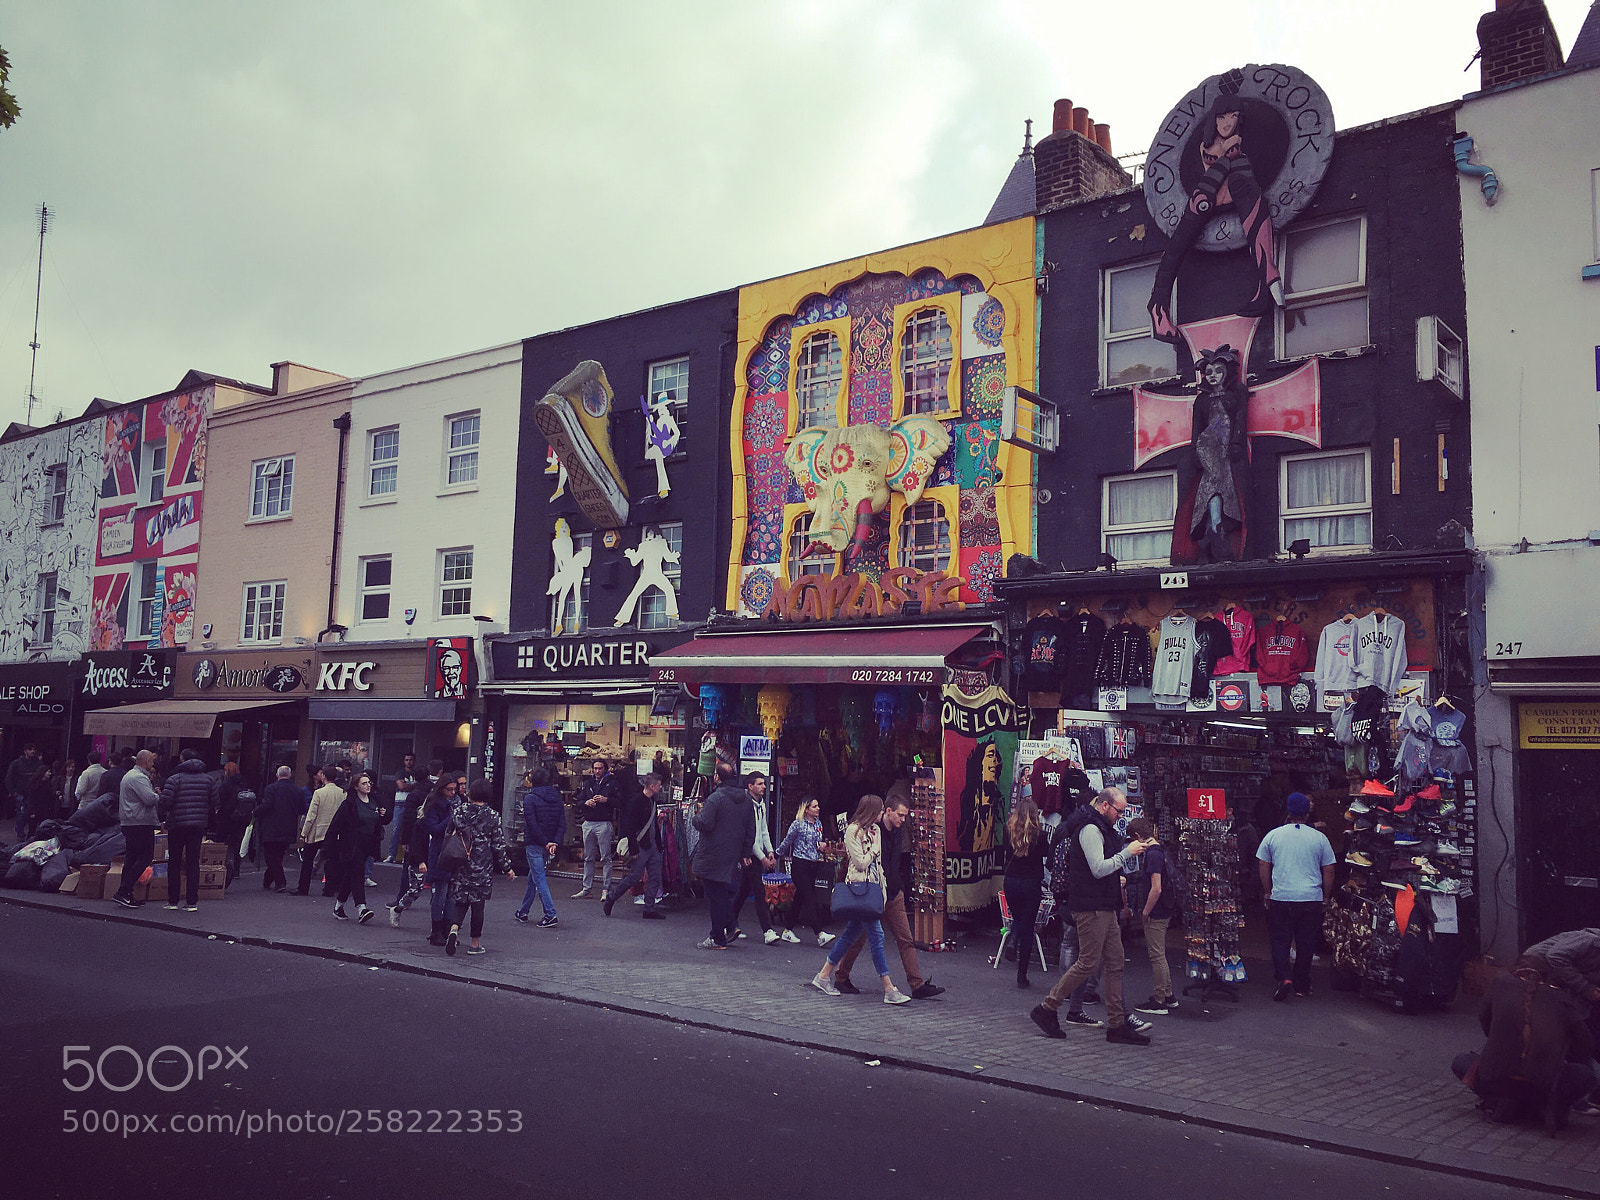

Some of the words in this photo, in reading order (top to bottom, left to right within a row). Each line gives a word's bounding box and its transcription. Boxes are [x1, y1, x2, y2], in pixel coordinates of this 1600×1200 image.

[1148, 85, 1208, 194] NEW
[1253, 68, 1322, 168] ROCK
[1216, 221, 1231, 240] &
[574, 489, 602, 501] QUARTER
[584, 502, 606, 513] SHOES
[1164, 576, 1186, 585] 245
[1163, 637, 1187, 650] BULLS
[1495, 642, 1522, 655] 247
[543, 641, 649, 672] QUARTER
[1168, 651, 1181, 662] 23
[316, 662, 372, 690] KFC
[658, 670, 675, 680] 243
[852, 670, 872, 681] 020
[875, 671, 902, 682] 7284
[906, 671, 933, 682] 1742
[19, 686, 50, 699] SHOP
[17, 704, 64, 713] ALDO
[1525, 708, 1569, 716] CAMDEN
[941, 701, 969, 732] ONE
[745, 739, 769, 751] ATM
[1198, 795, 1215, 813] £1
[946, 857, 972, 879] BOB
